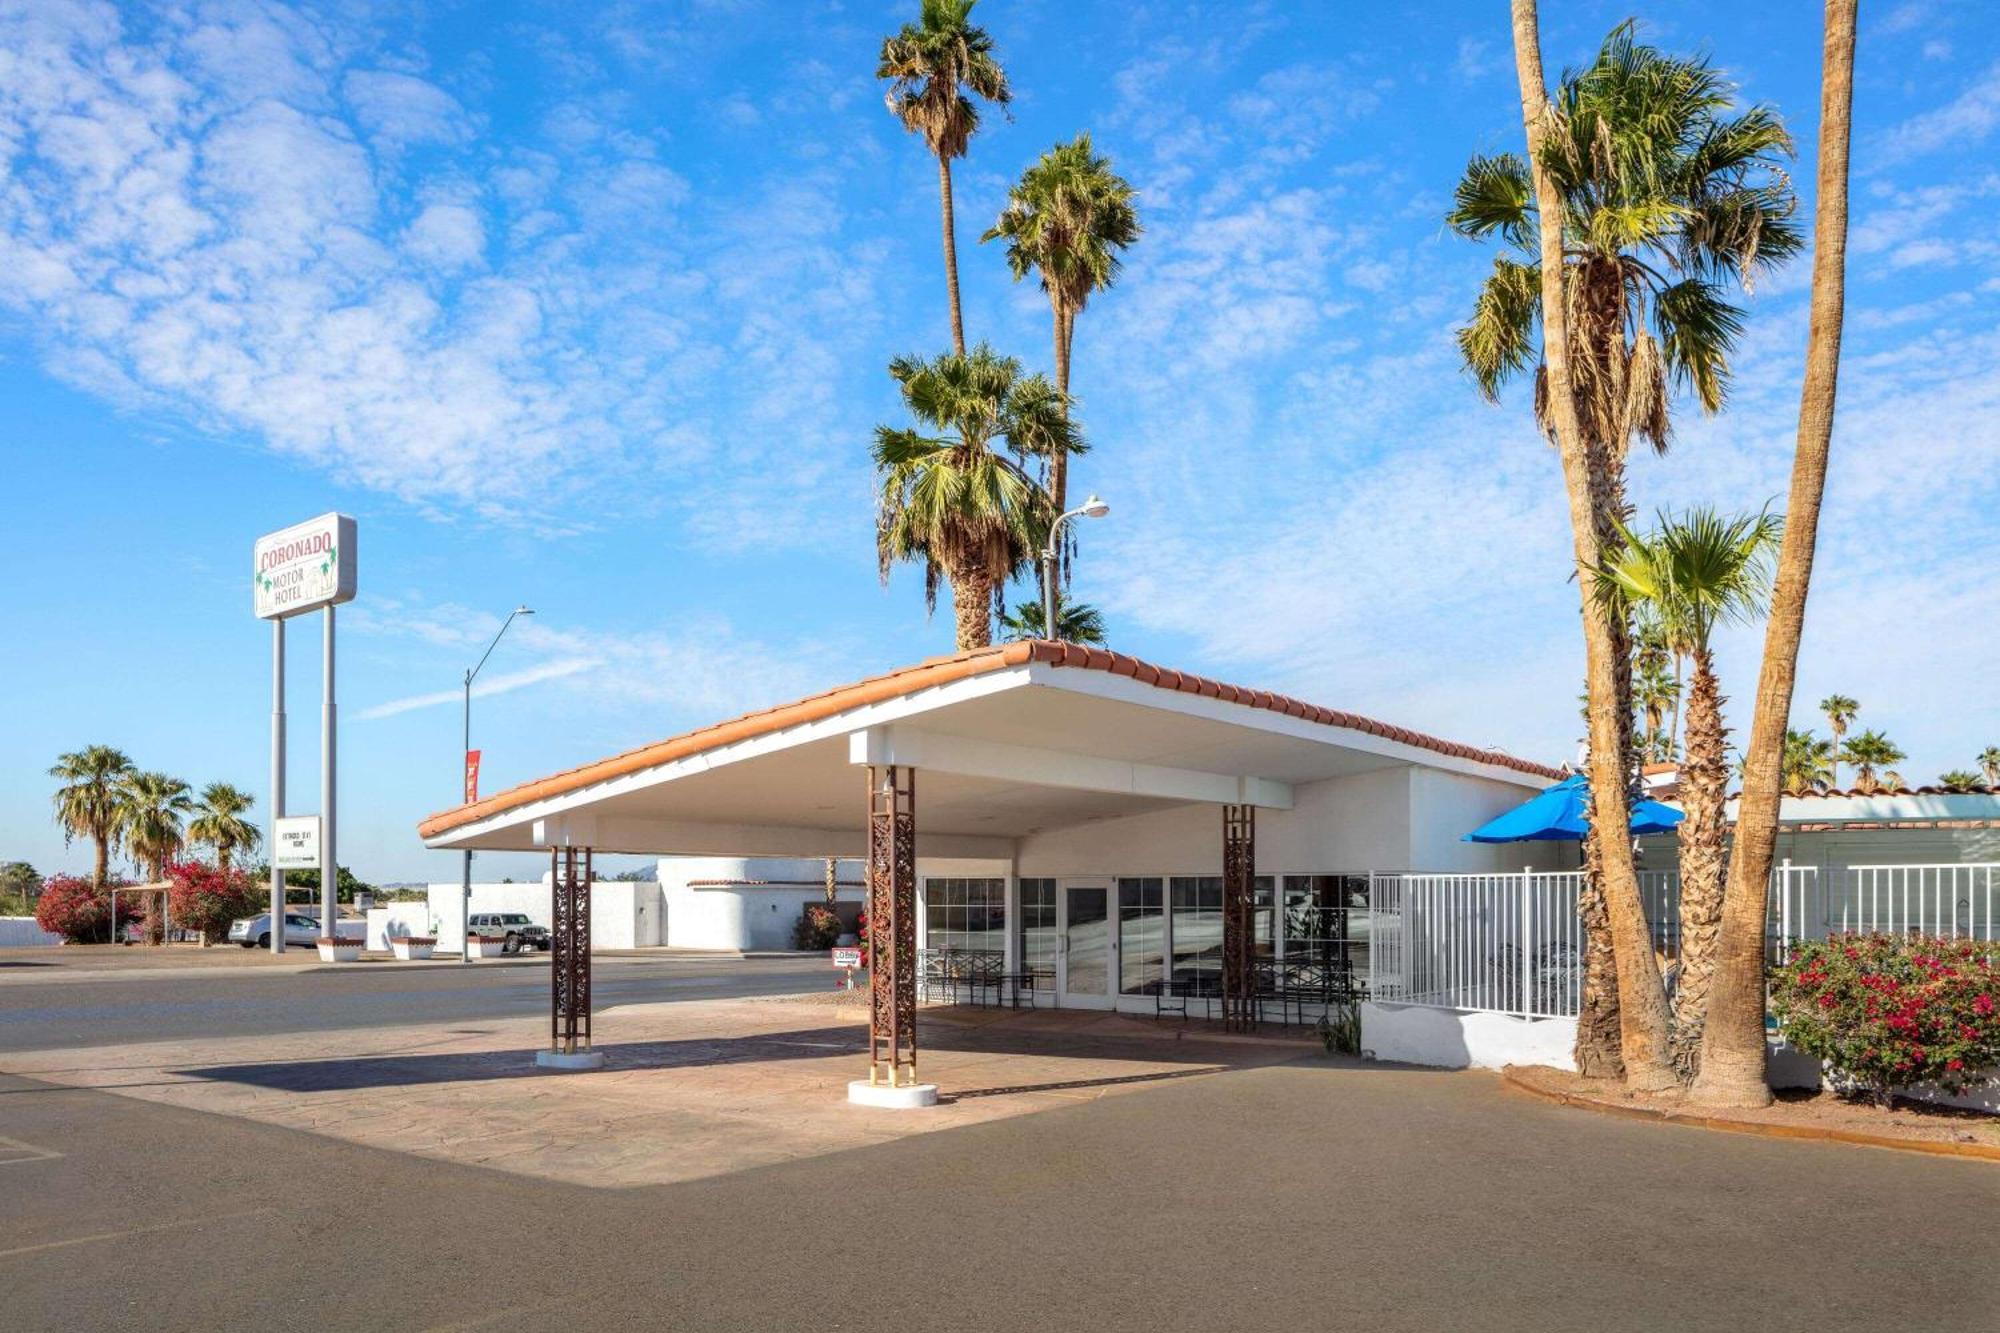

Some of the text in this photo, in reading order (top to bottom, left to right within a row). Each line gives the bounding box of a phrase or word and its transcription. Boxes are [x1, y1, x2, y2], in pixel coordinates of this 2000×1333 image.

[262, 532, 331, 572] CORONADO
[273, 568, 304, 588] MOTOR
[275, 586, 302, 605] HOTEL
